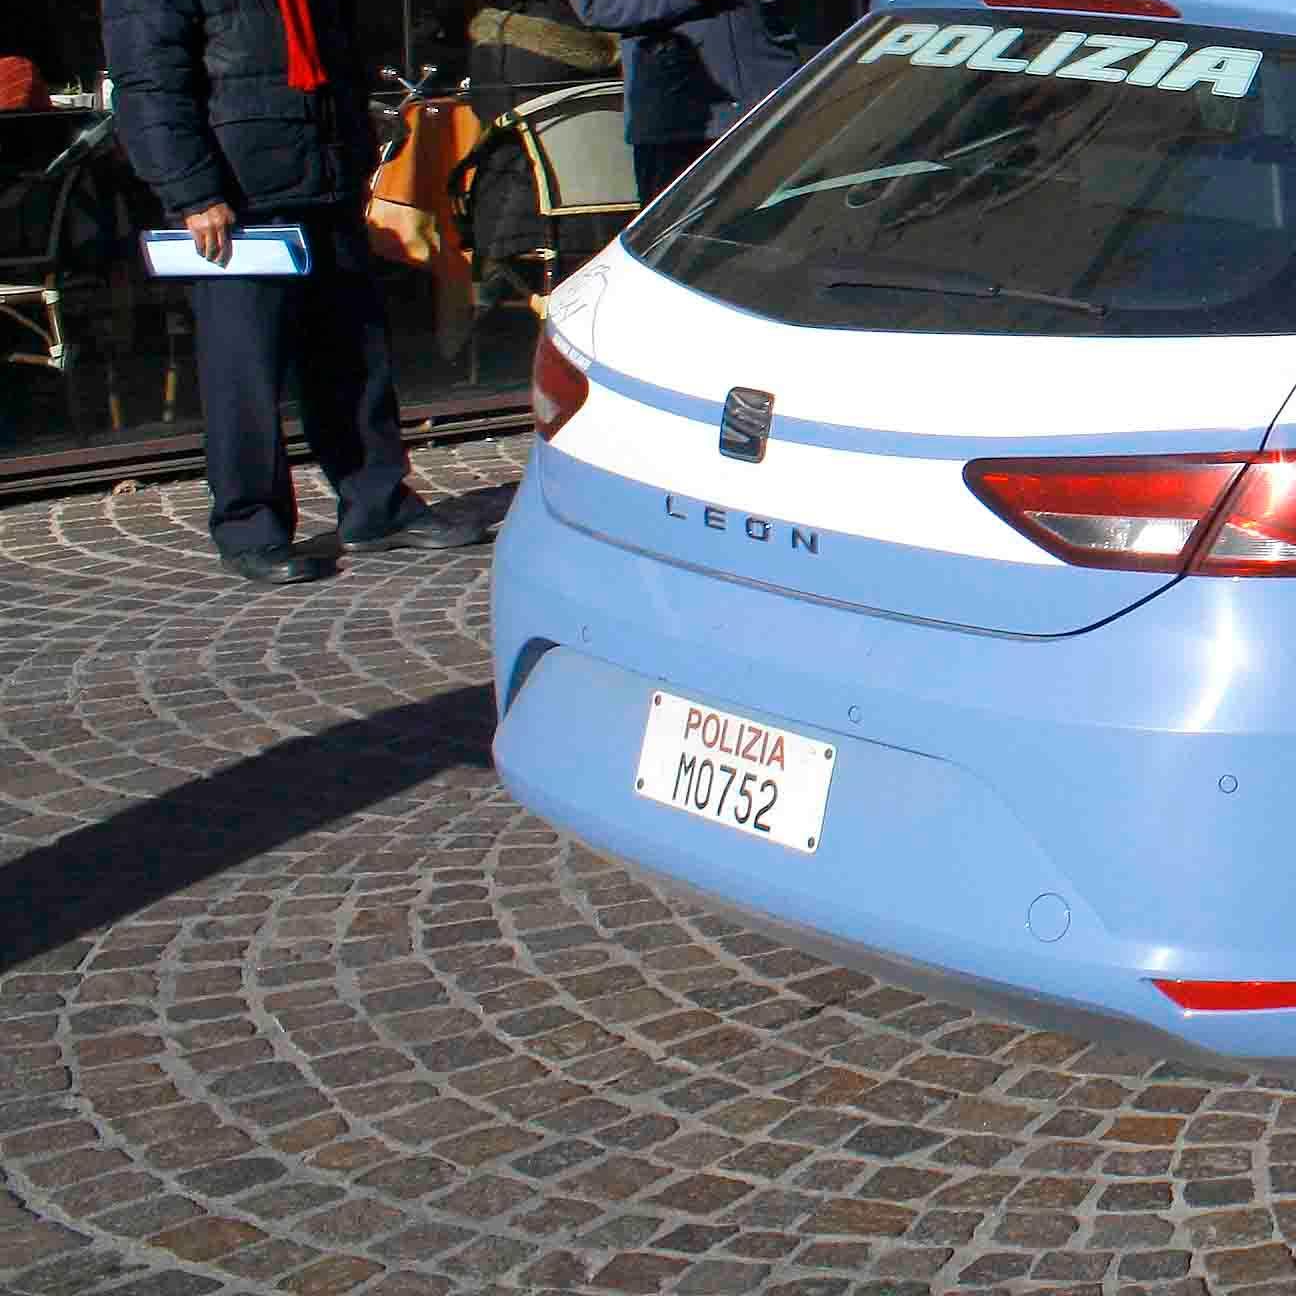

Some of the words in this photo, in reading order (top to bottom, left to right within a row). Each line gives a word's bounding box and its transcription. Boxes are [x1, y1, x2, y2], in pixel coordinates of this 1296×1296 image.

[857, 23, 1264, 98] POLIZIA
[665, 494, 819, 555] LEON
[684, 707, 785, 772] POLIZIA
[672, 751, 779, 833] M0752
